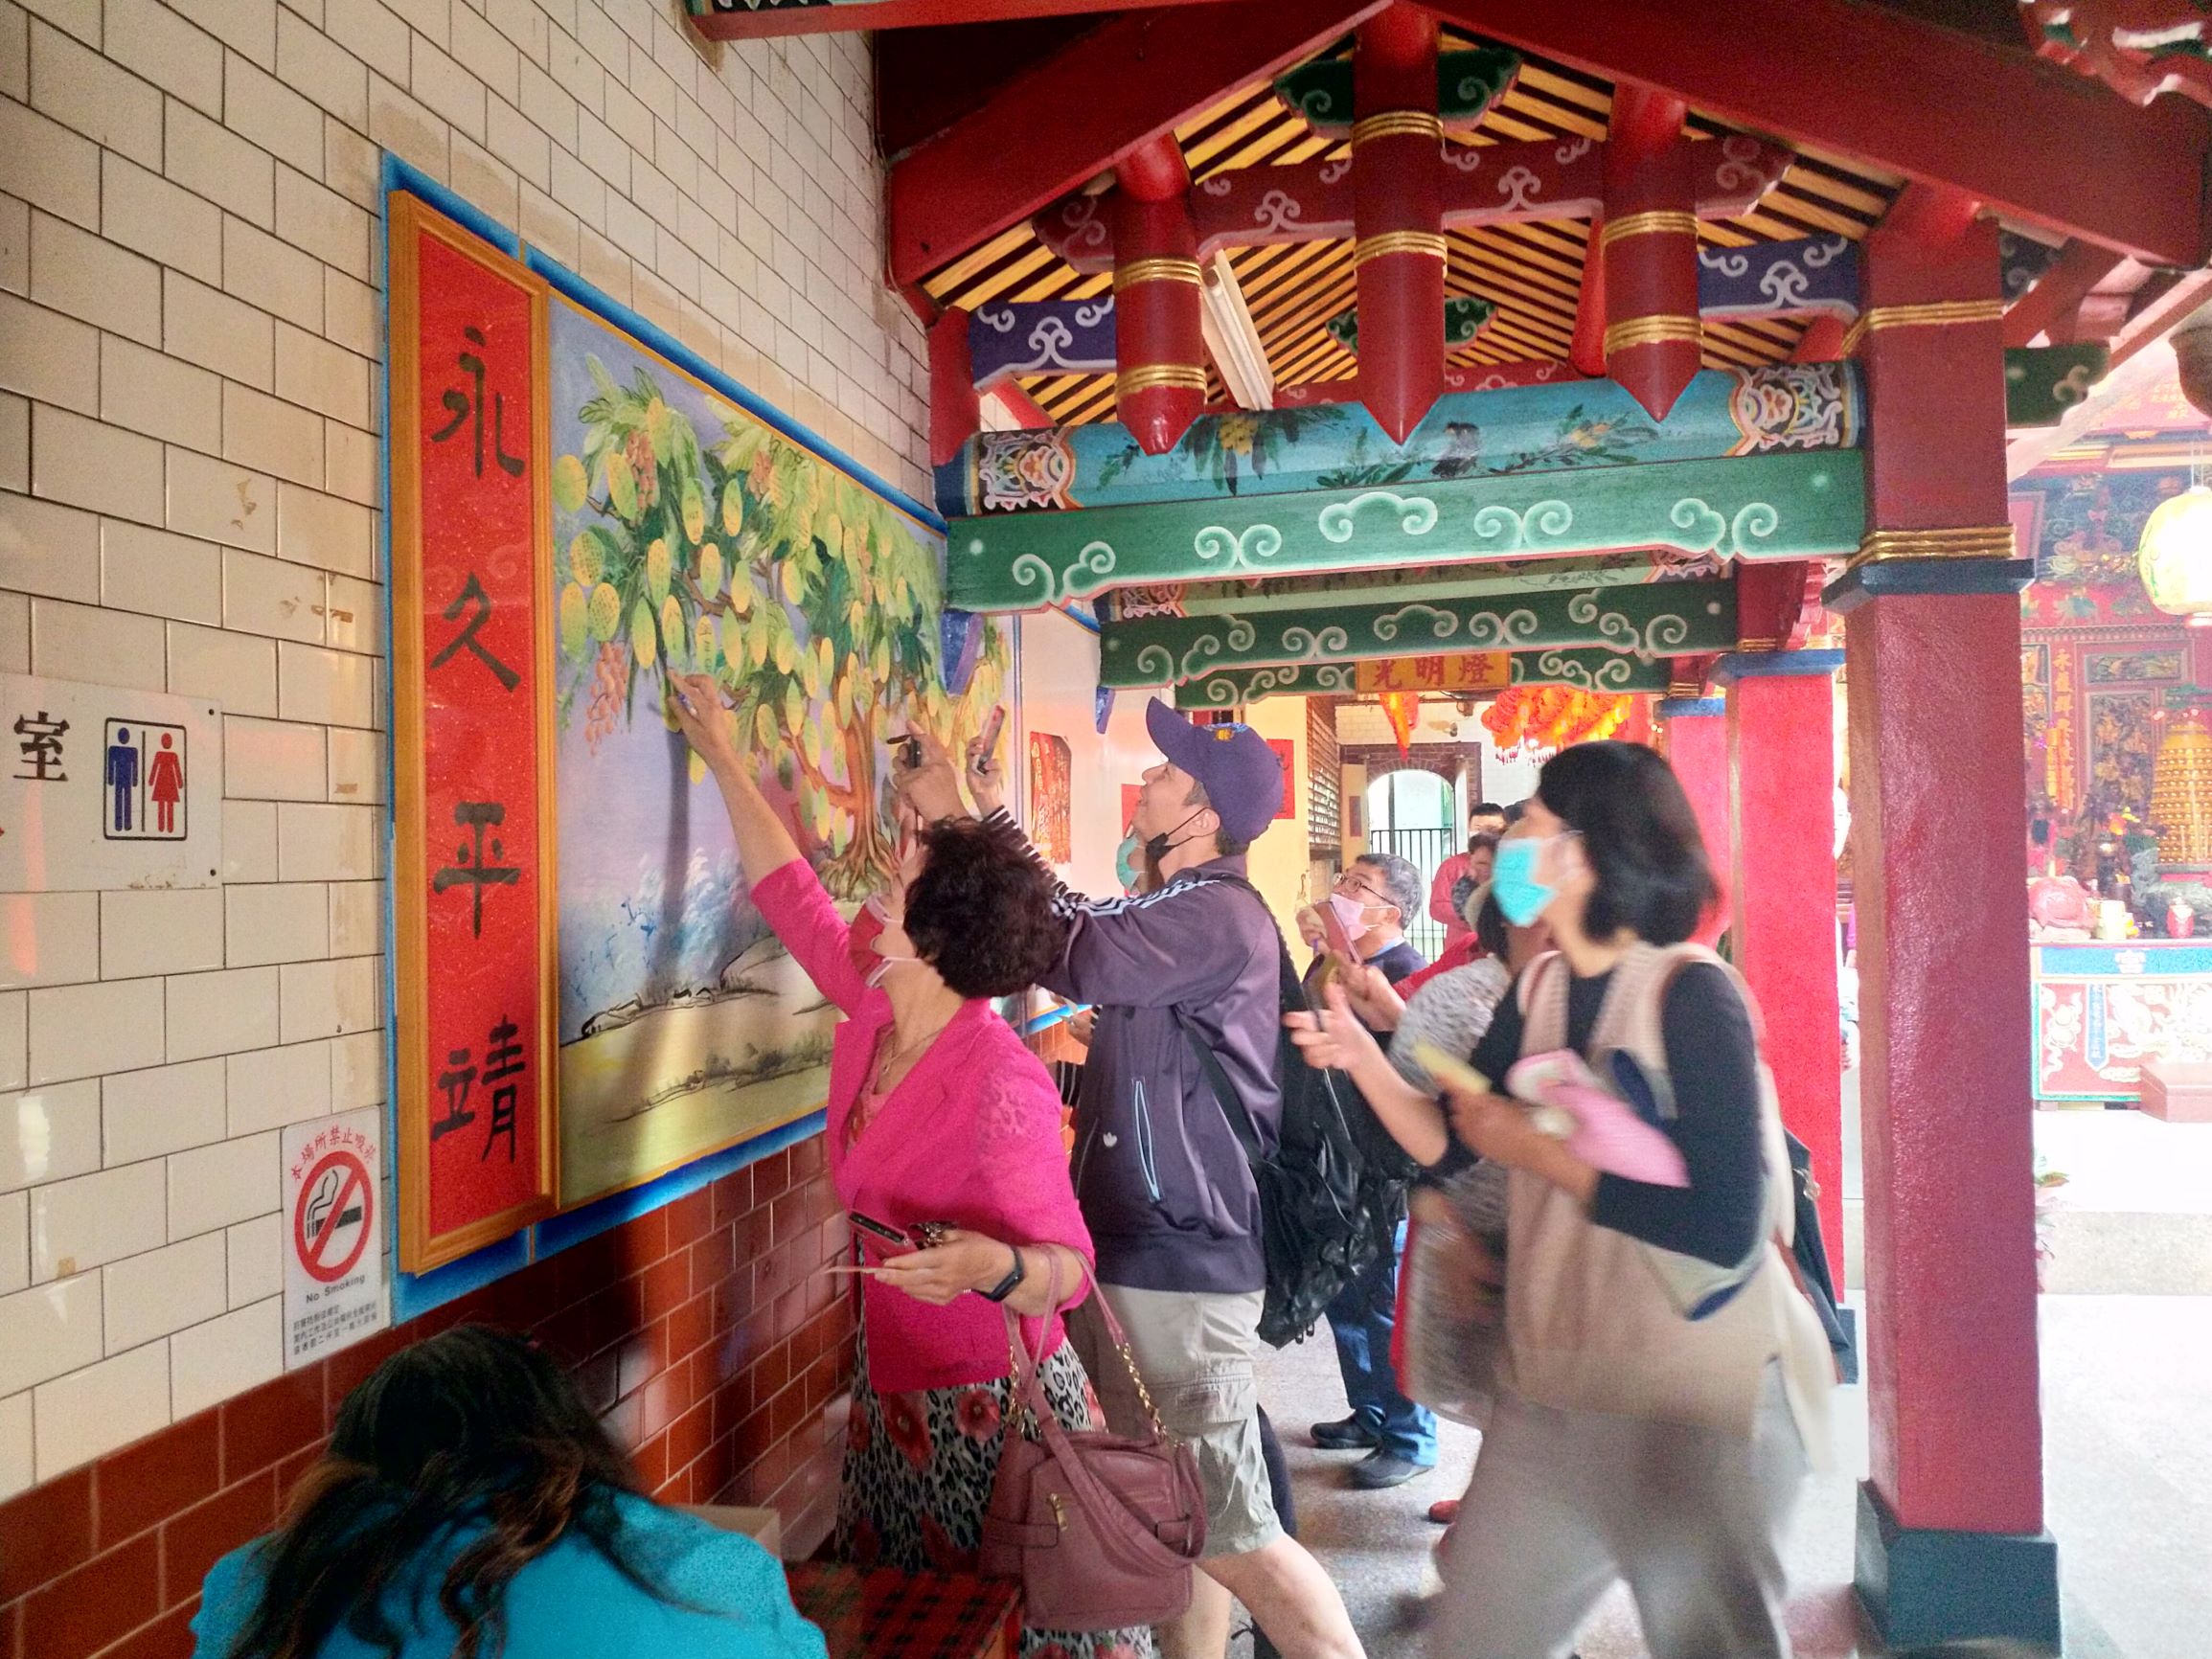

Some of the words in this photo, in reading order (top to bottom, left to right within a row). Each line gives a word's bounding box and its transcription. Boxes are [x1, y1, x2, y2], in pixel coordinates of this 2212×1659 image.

[1372, 653, 1494, 690] 光明燈
[13, 711, 70, 782] 室
[430, 325, 526, 1164] 永久平靖
[306, 1292, 320, 1304] No
[325, 1274, 366, 1297] Smoking
